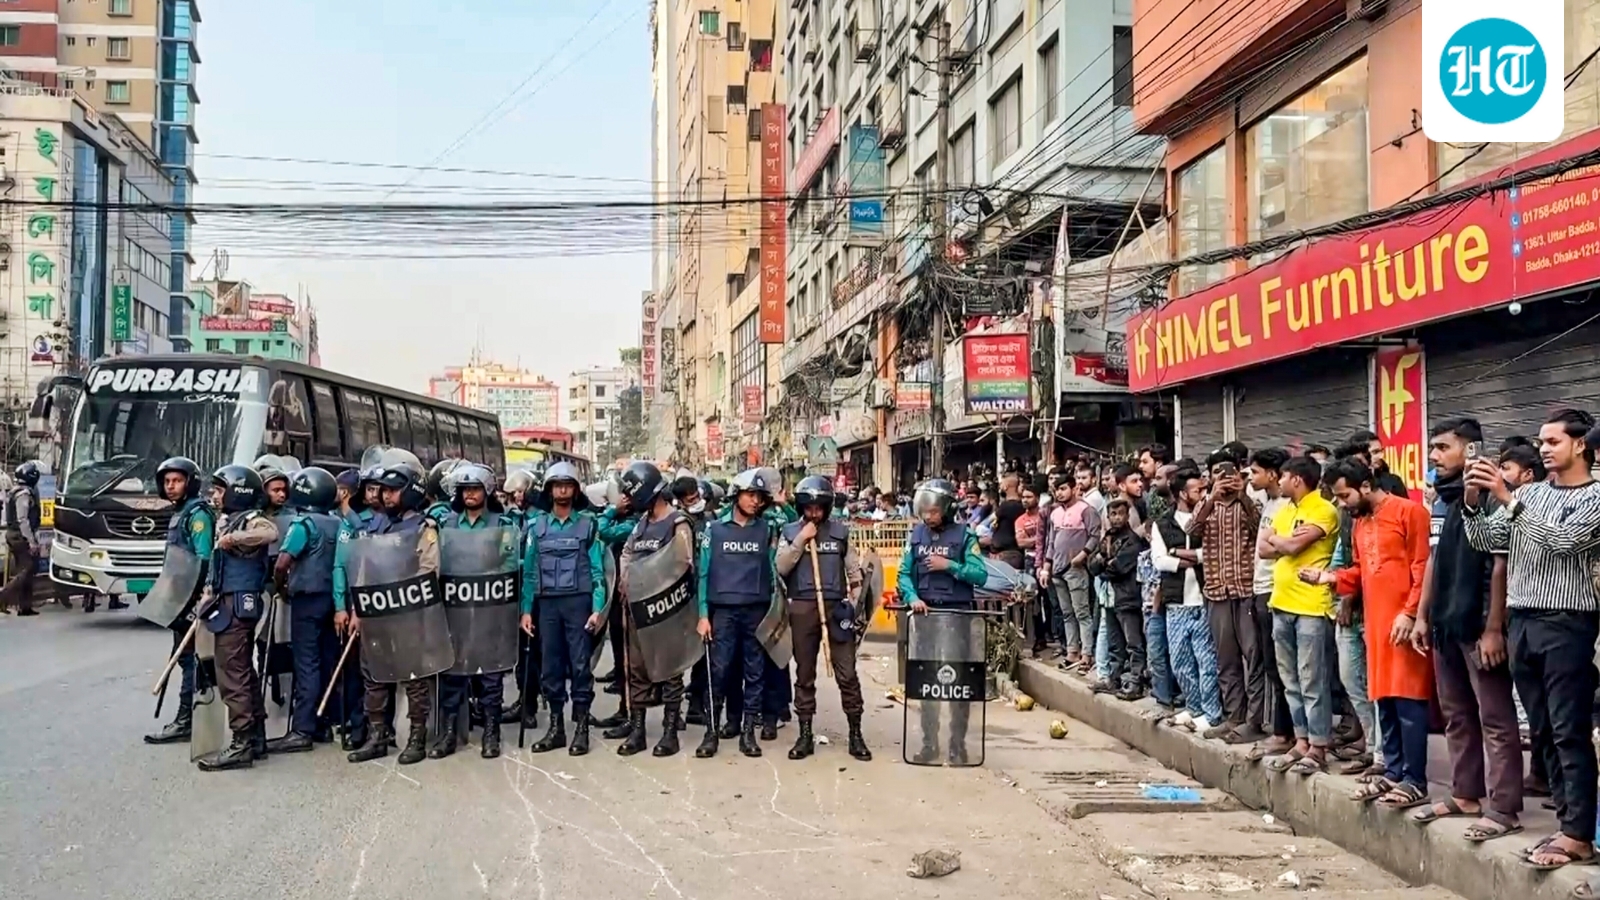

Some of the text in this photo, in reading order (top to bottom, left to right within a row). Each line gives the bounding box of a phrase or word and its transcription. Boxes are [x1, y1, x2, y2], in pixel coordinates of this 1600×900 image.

[1547, 230, 1567, 244] Uttar
[1156, 293, 1252, 369] HIMEL
[1260, 225, 1490, 340] Furniture
[88, 366, 259, 394] PURBASHA
[970, 400, 1026, 412] WALTON
[722, 541, 759, 551] POLICE
[918, 545, 948, 556] POLICE
[358, 579, 434, 612] POLICE
[445, 578, 514, 602] POLICE
[647, 583, 689, 618] POLICE
[922, 683, 971, 699] POLICE
